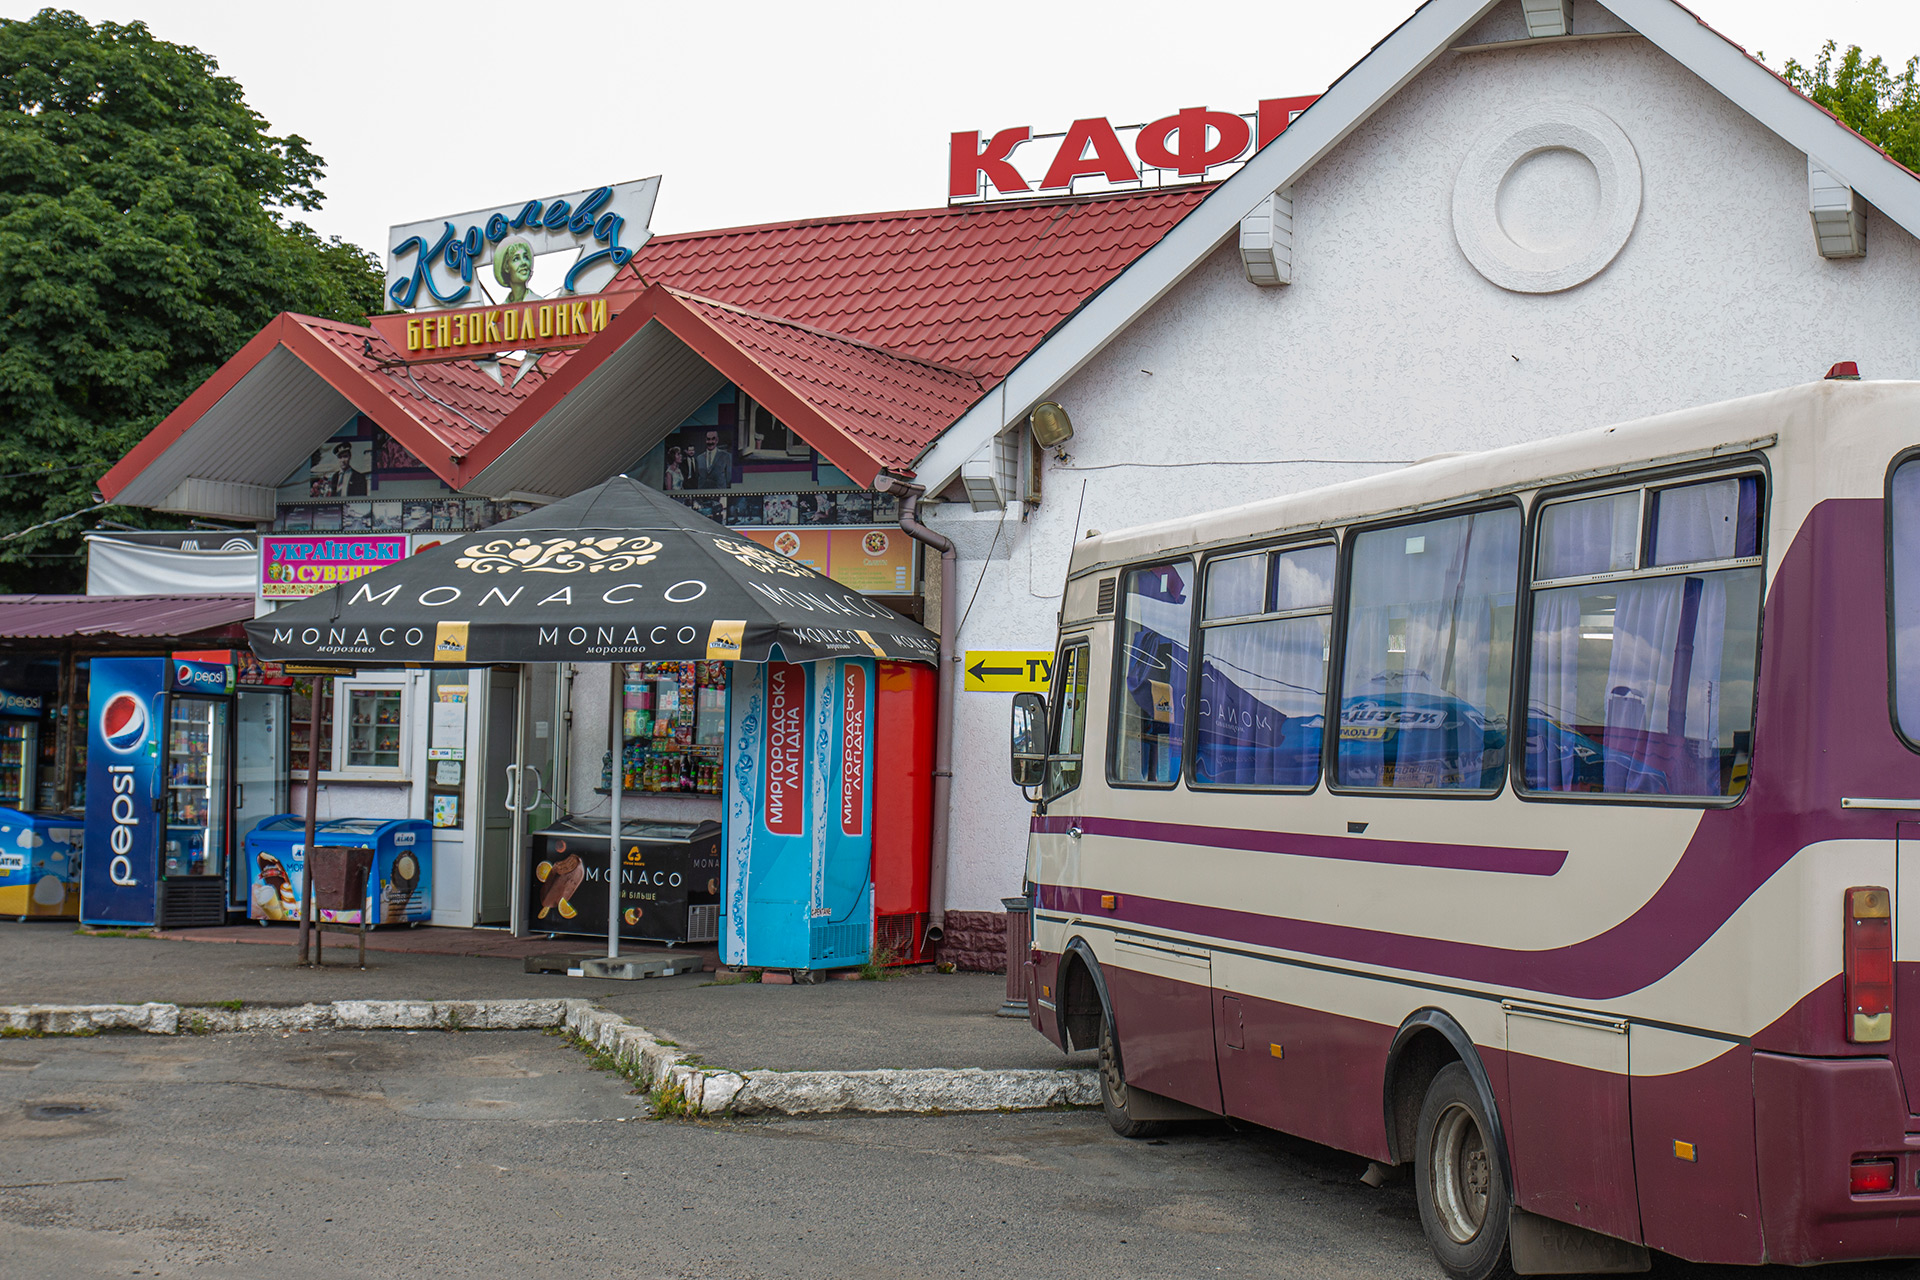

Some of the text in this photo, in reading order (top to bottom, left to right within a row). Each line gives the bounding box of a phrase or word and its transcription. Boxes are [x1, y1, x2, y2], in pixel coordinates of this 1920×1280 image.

[389, 186, 633, 307] Королева
[406, 299, 608, 351] БЕНЗОКОЛОНКИ
[270, 540, 401, 561] УКРАЇНСЬКІ
[347, 579, 707, 607] MONACO
[747, 582, 895, 620] MONACO
[271, 627, 424, 646] MONACO
[538, 625, 696, 646] MONACO
[792, 627, 861, 645] MONACO
[316, 645, 376, 655] морозиво
[586, 645, 646, 656] морозиво
[193, 671, 224, 685] pepsi
[1026, 660, 1054, 682] ТУ
[6, 693, 42, 710] pepsi
[769, 670, 786, 825] МИРГОРОДСЬКА
[785, 706, 801, 789] ЛАГІДНА
[843, 672, 855, 825] МИРГОРОДСЬКА
[852, 710, 863, 790] ЛАГІДНА
[107, 764, 140, 887] pepsi
[0, 858, 21, 866] АТИК
[286, 864, 304, 872] МОР
[693, 859, 720, 868] MONA
